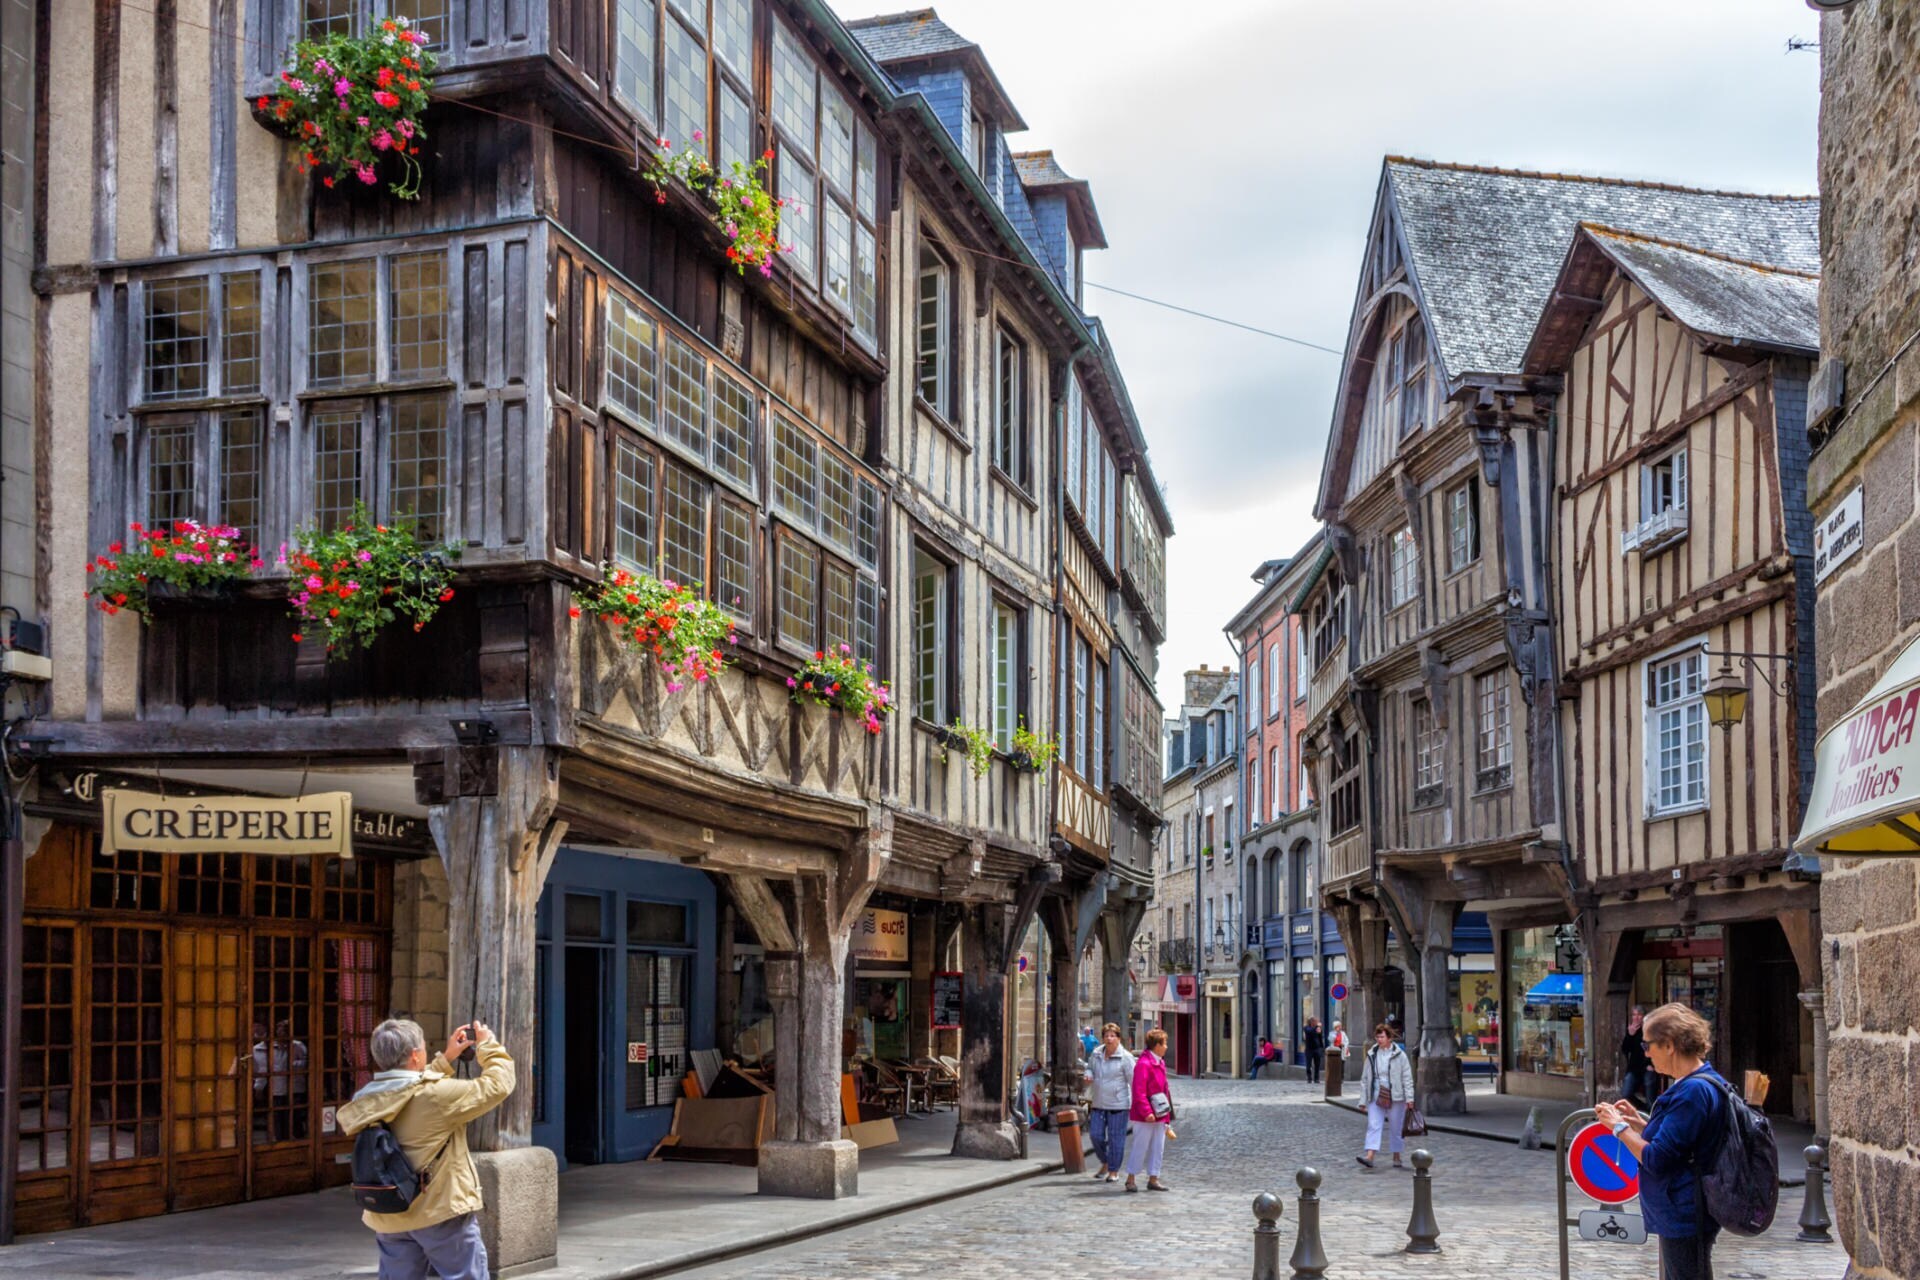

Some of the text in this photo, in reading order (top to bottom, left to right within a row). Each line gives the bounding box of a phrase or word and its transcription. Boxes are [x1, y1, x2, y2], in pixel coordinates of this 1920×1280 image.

[1828, 508, 1845, 536] PLACE
[1816, 520, 1860, 575] DES MERCIERS
[1838, 687, 1920, 775] JUNCA
[1825, 763, 1903, 818] Joailliers
[124, 803, 333, 841] CRÊPERIE
[881, 915, 905, 936] sucré
